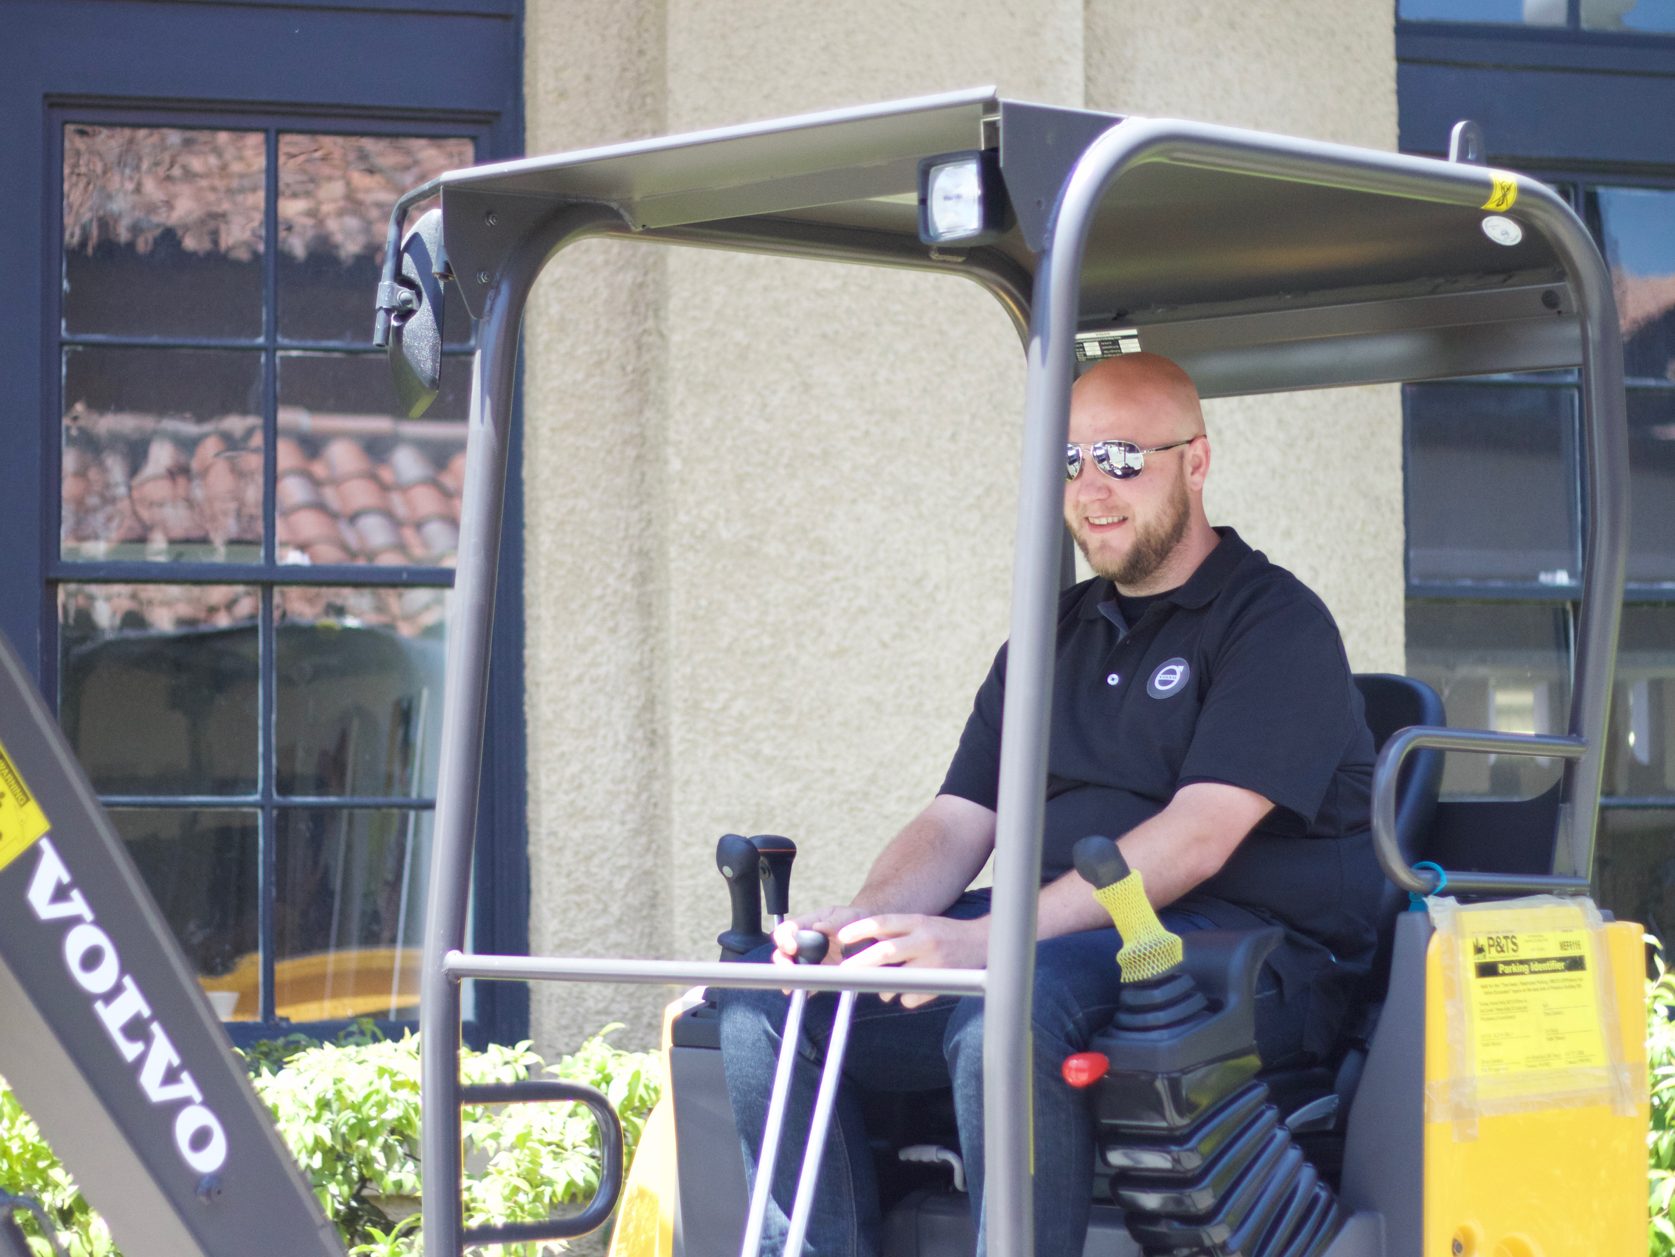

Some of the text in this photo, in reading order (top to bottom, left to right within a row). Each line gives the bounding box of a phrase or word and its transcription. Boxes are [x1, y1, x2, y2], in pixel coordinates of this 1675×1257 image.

[1487, 935, 1519, 954] P&TS
[1498, 960, 1565, 974] Parking Identifier
[27, 837, 228, 1173] VOLVO
